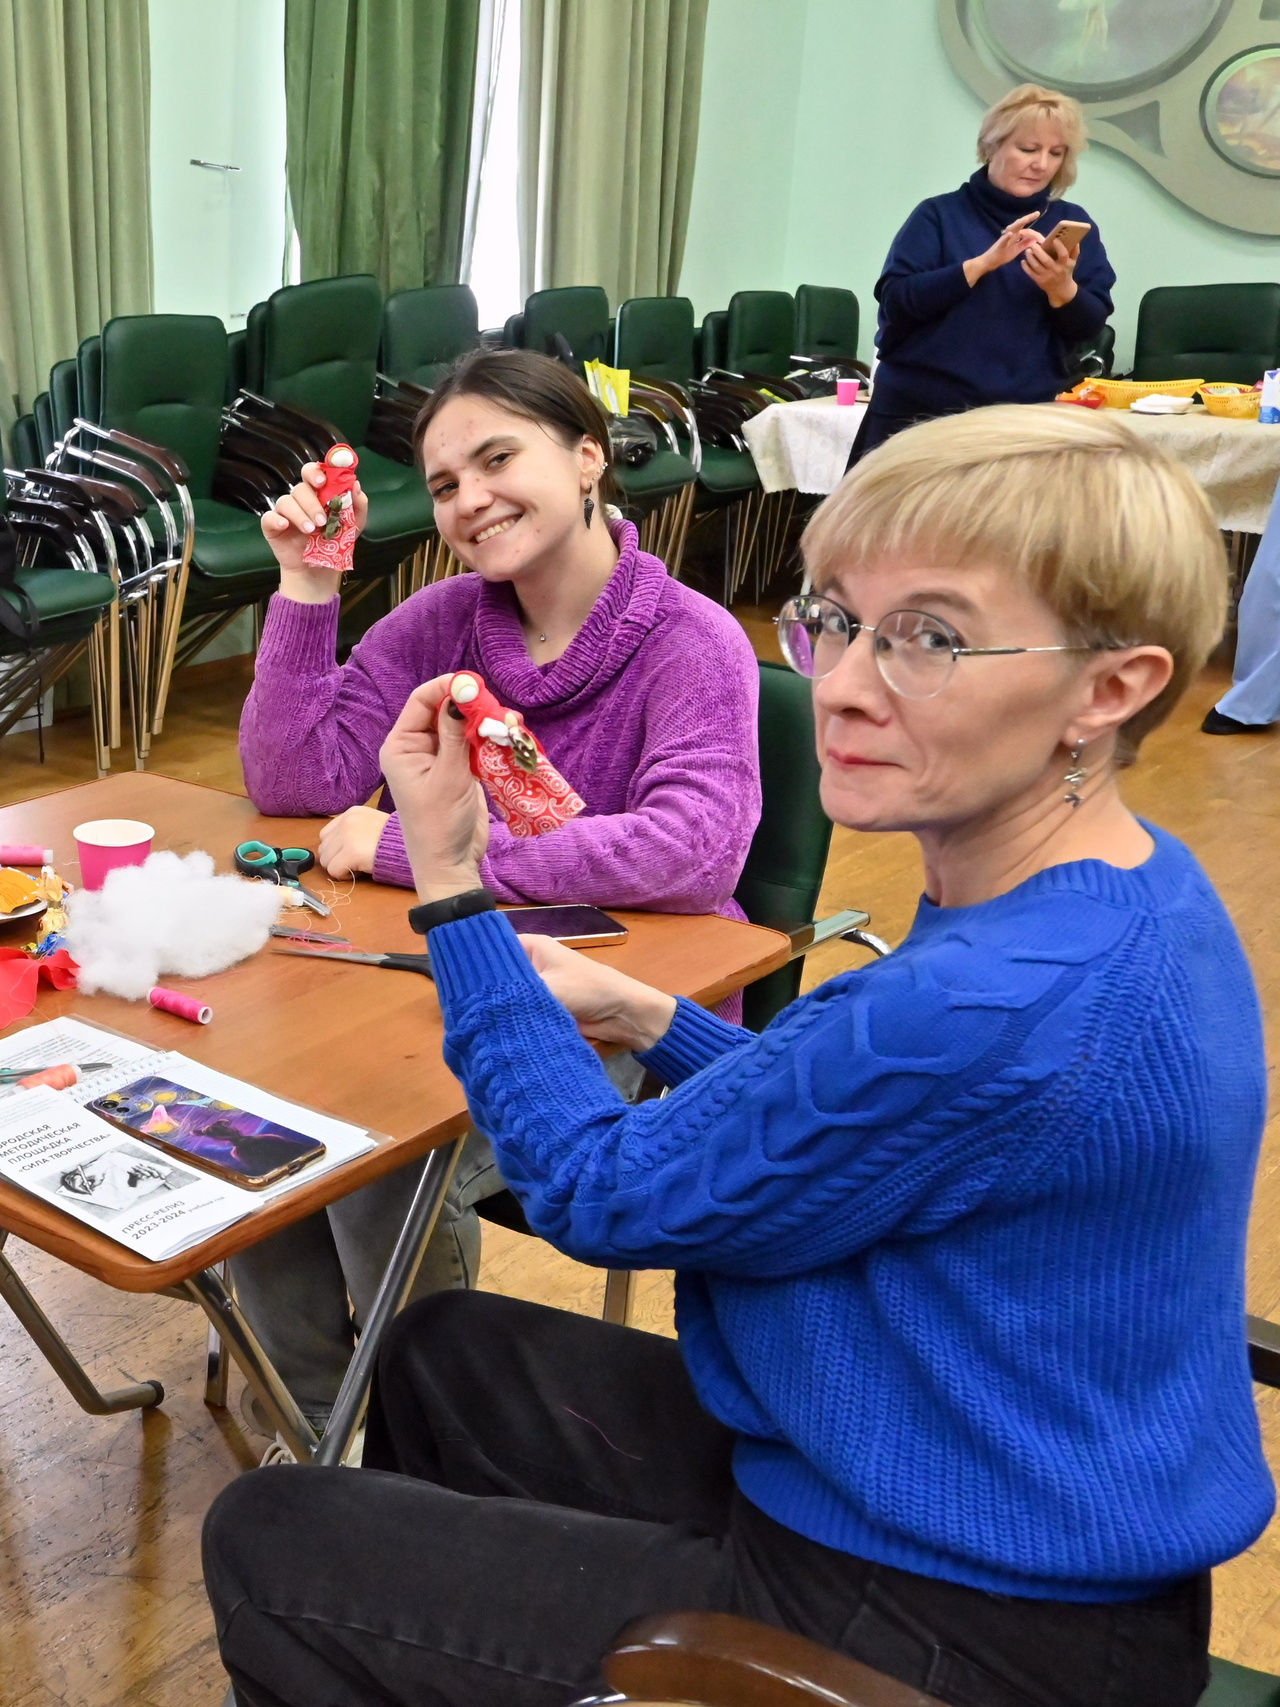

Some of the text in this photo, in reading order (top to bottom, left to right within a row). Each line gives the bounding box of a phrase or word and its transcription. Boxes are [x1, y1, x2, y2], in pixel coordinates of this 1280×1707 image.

[7, 1137, 73, 1165] ПЛОЩАДКА
[18, 1133, 112, 1173] «СИЛА ТВОРЧЕСТВА»
[121, 1200, 185, 1234] ПРЕСС-РЕЛИЗ
[132, 1209, 186, 1240] 2023-2024
